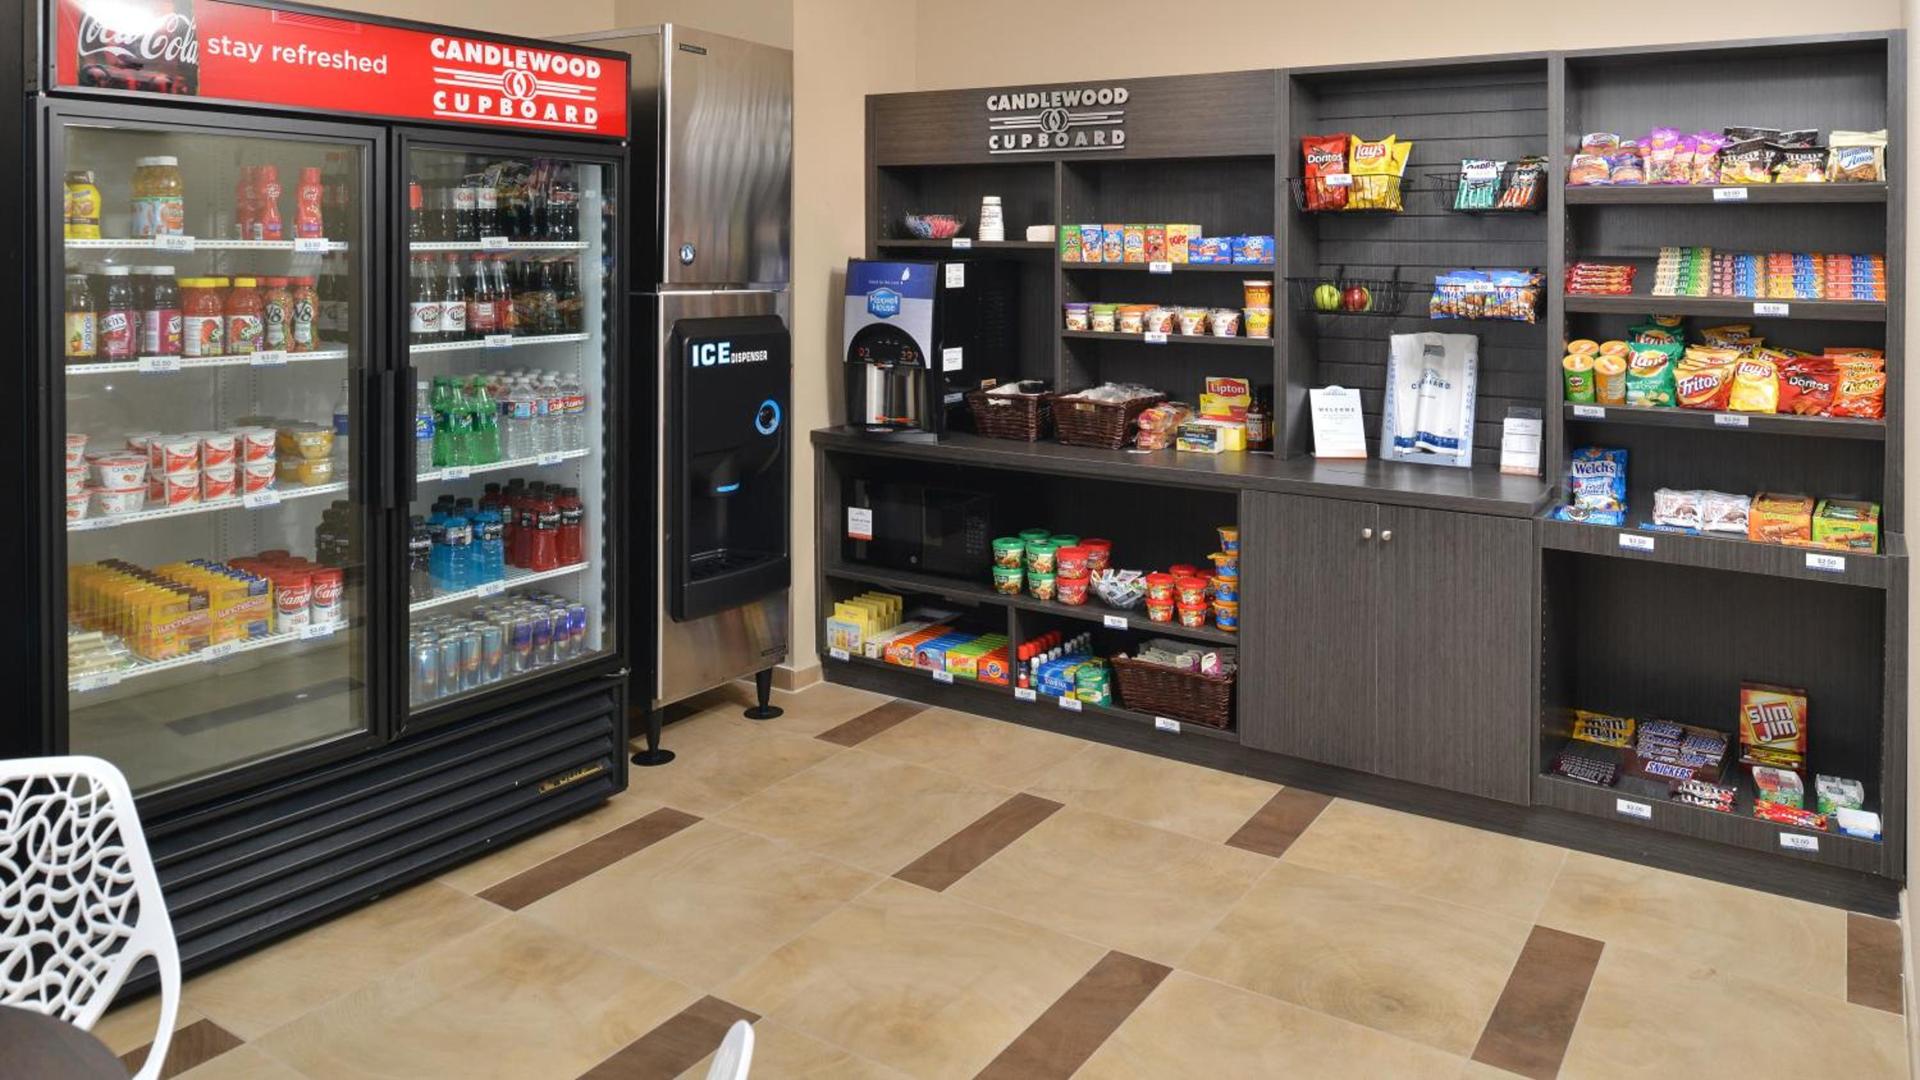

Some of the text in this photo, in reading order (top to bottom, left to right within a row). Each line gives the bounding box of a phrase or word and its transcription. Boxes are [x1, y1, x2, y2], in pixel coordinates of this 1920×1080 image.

[207, 35, 388, 75] stay refreshed
[430, 37, 601, 79] CANDLEWOOD
[433, 90, 598, 124] CUPBOARD
[986, 87, 1129, 111] CANDLEWOOD
[988, 129, 1126, 150] CUPBOARD
[1307, 153, 1343, 164] Doritos
[692, 341, 768, 367] ICE DISPENSER
[1210, 383, 1245, 395] Lipton
[1679, 375, 1719, 396] Fritos
[1788, 376, 1830, 391] Doritos
[1574, 462, 1615, 474] Welch's
[1560, 763, 1613, 783] HERSHEY'S
[1648, 761, 1692, 779] SNICKERS
